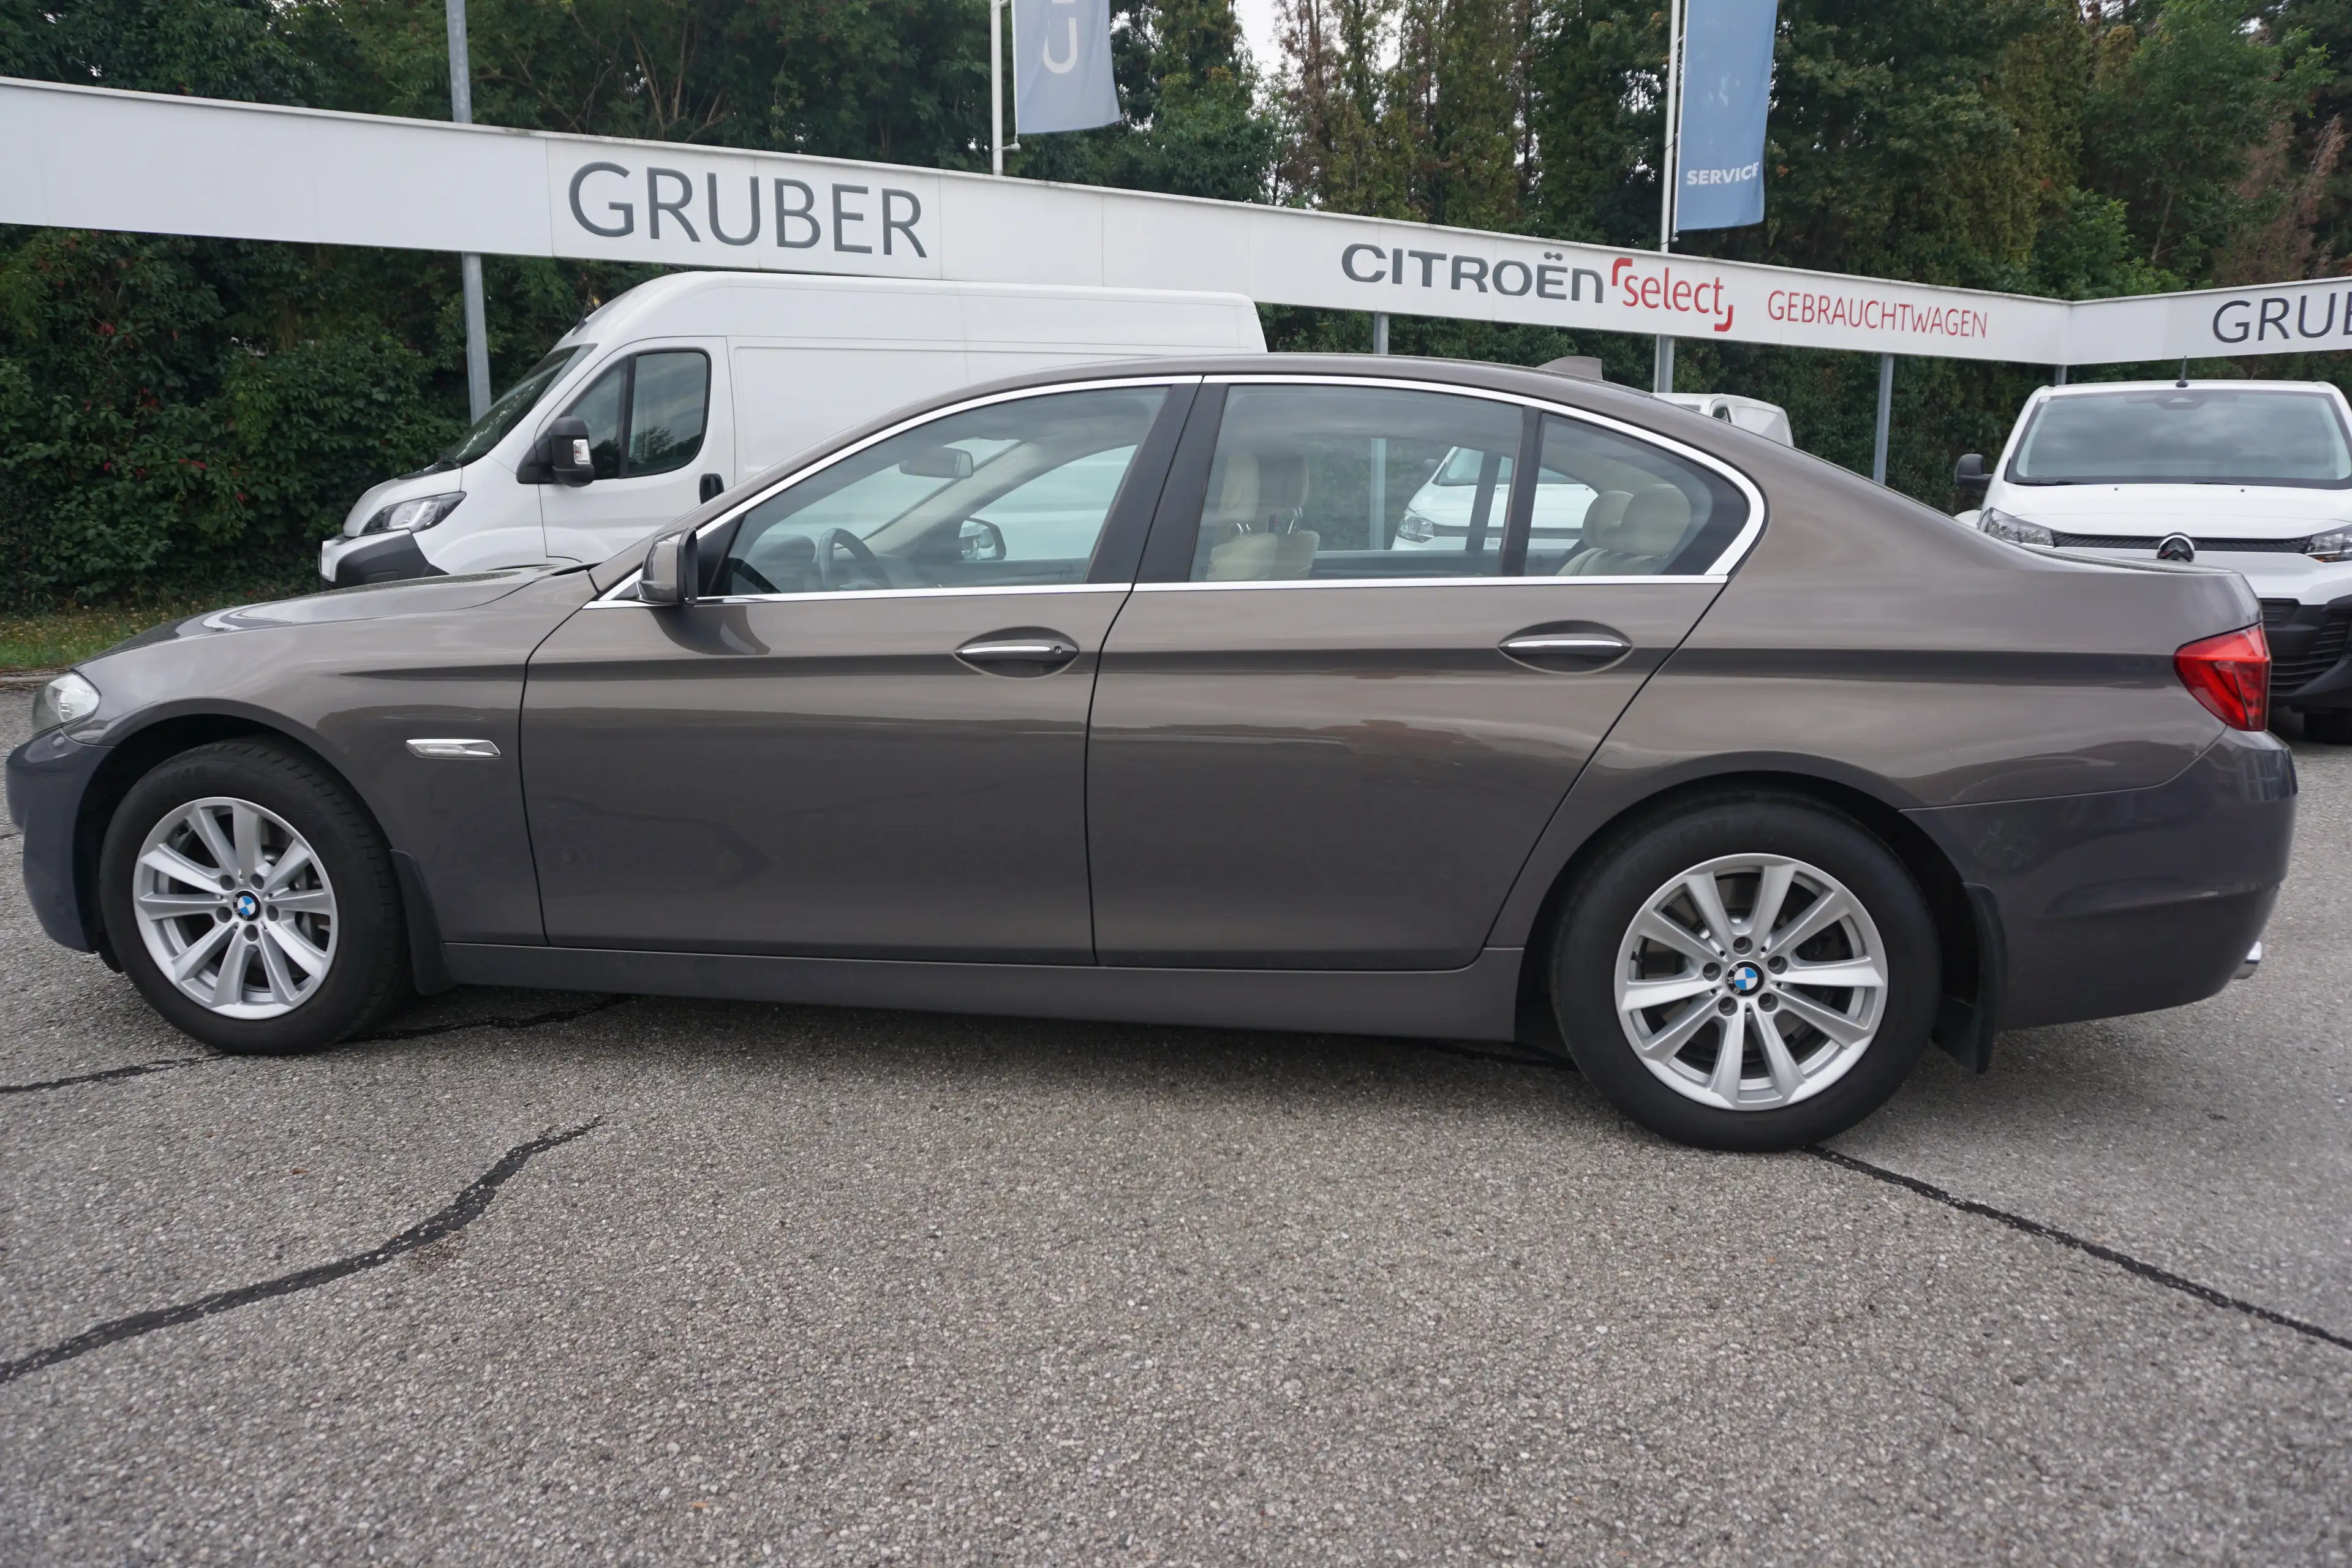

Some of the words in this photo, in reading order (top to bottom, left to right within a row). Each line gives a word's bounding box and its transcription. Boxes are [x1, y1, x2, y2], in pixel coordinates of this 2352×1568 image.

[568, 161, 927, 258] GRUBER
[1622, 268, 1724, 315] select
[1768, 289, 1988, 339] GEBRAUCHTWAGEN
[2212, 291, 2352, 343] GRU
